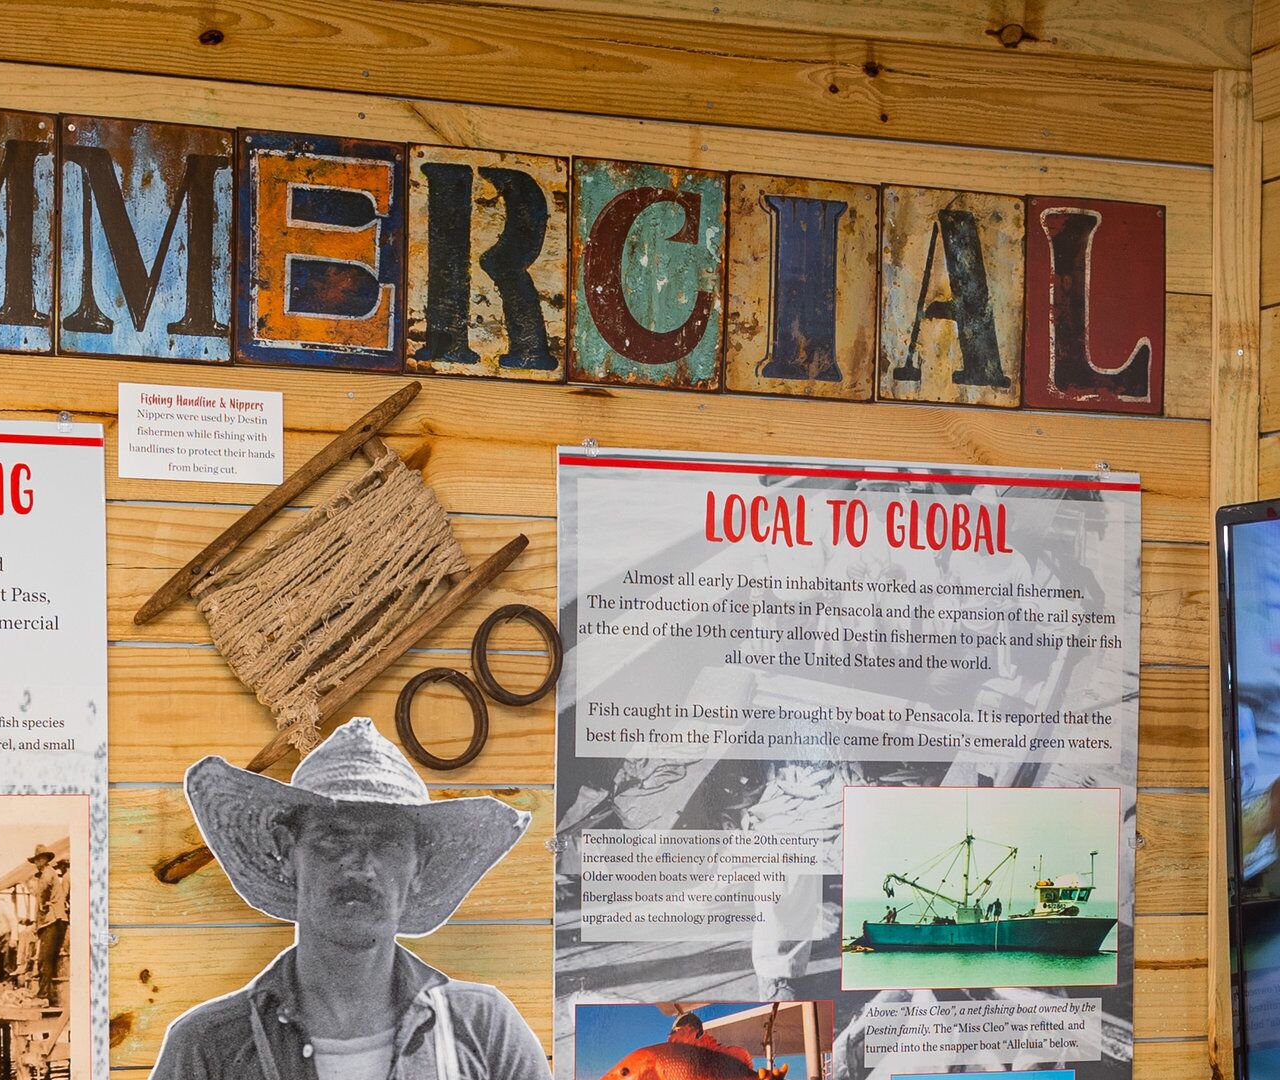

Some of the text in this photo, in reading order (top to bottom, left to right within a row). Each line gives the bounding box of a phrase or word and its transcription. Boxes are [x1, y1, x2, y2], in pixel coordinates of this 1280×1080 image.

[139, 394, 264, 411] Fishing Handline & Nippers
[168, 462, 237, 475] from being cut.
[705, 491, 1012, 555] LOCAL TO GLOBAL
[622, 569, 1084, 599] Almost all early Destin inhabitants worked as commercial fishermen.
